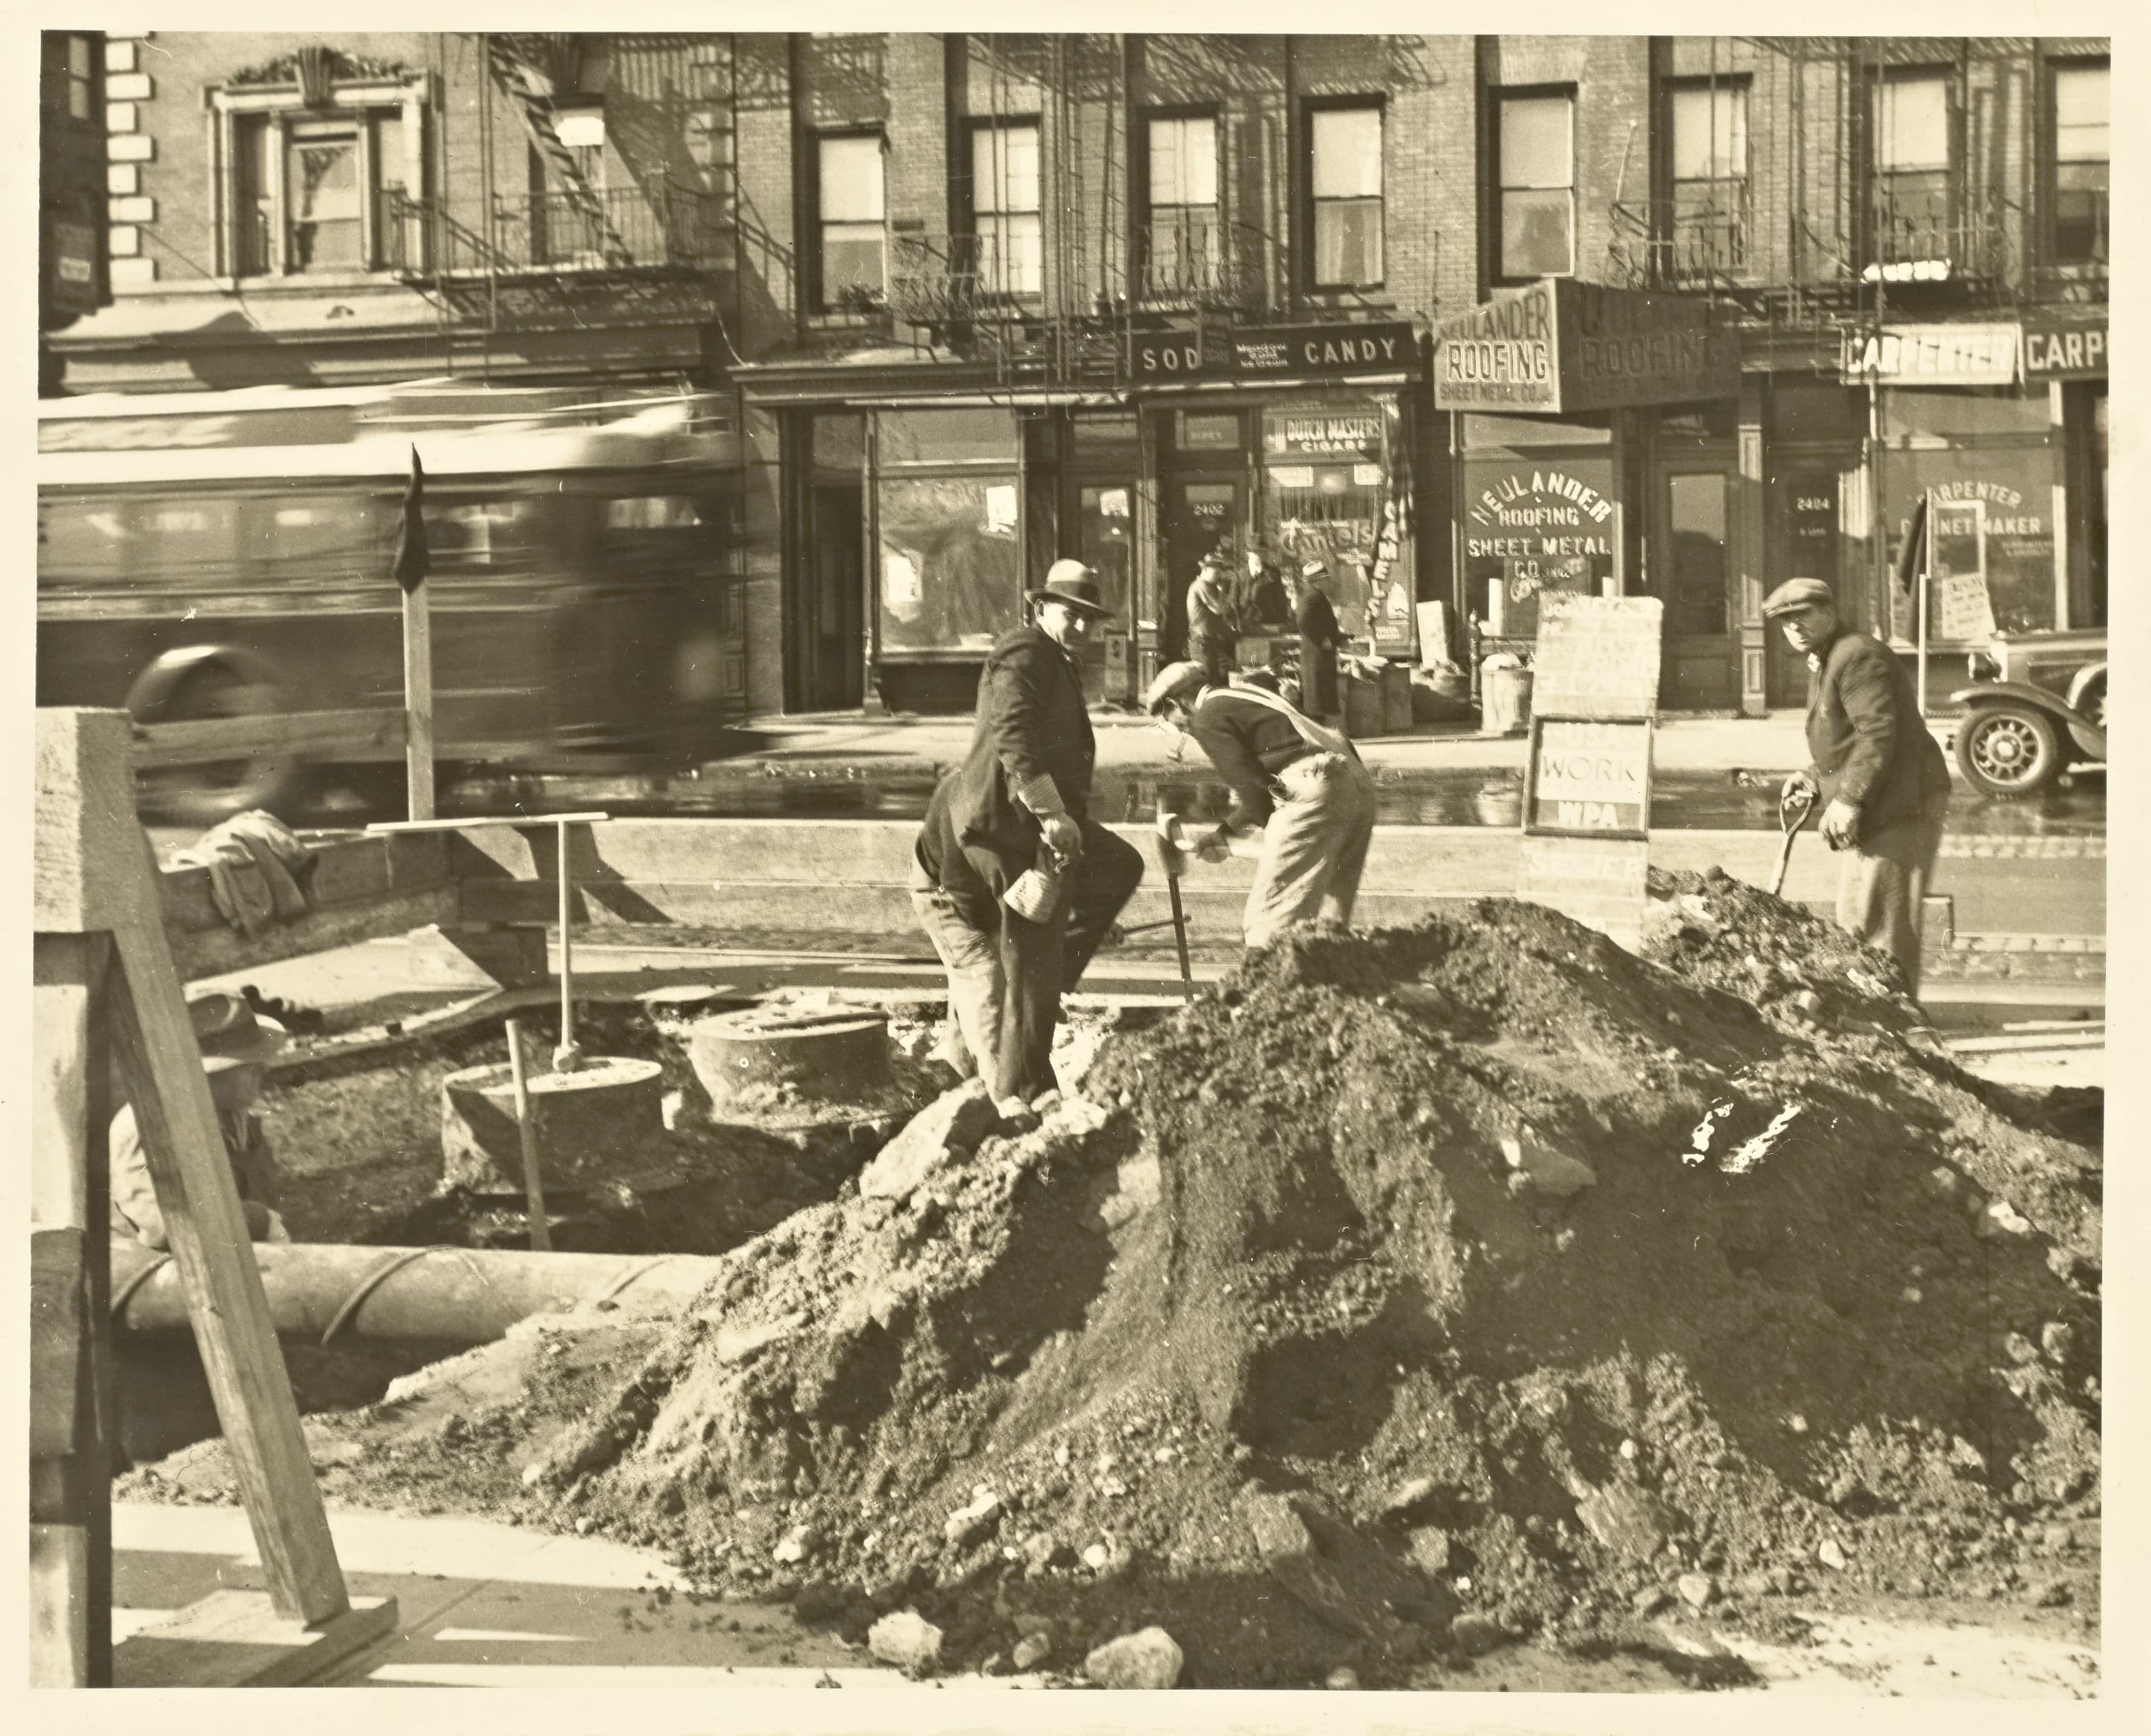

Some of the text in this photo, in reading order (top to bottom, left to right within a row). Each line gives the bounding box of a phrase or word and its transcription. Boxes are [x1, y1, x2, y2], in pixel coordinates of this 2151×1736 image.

[1439, 290, 1551, 341] NEULANDER
[1142, 346, 1200, 371] SOD
[1304, 337, 1396, 364] CANDY
[1446, 341, 1549, 384] ROOFING
[1846, 335, 2013, 373] CARPENTER
[2026, 331, 2109, 371] CARP
[1440, 384, 1477, 402] SHEET
[1287, 417, 1381, 441] DUTCH MASTERS
[1301, 439, 1367, 453] CIGARS
[1193, 503, 1225, 516] 2402
[1468, 470, 1613, 526] NEULANDER
[1797, 497, 1831, 511] 2404
[1498, 506, 1580, 527] ROOFING
[1900, 518, 1973, 535] CNET
[1367, 500, 1397, 619] CAMELS
[1468, 536, 1612, 557] SHEET METAL
[1542, 755, 1636, 782] WORK
[1557, 801, 1620, 830] WPA
